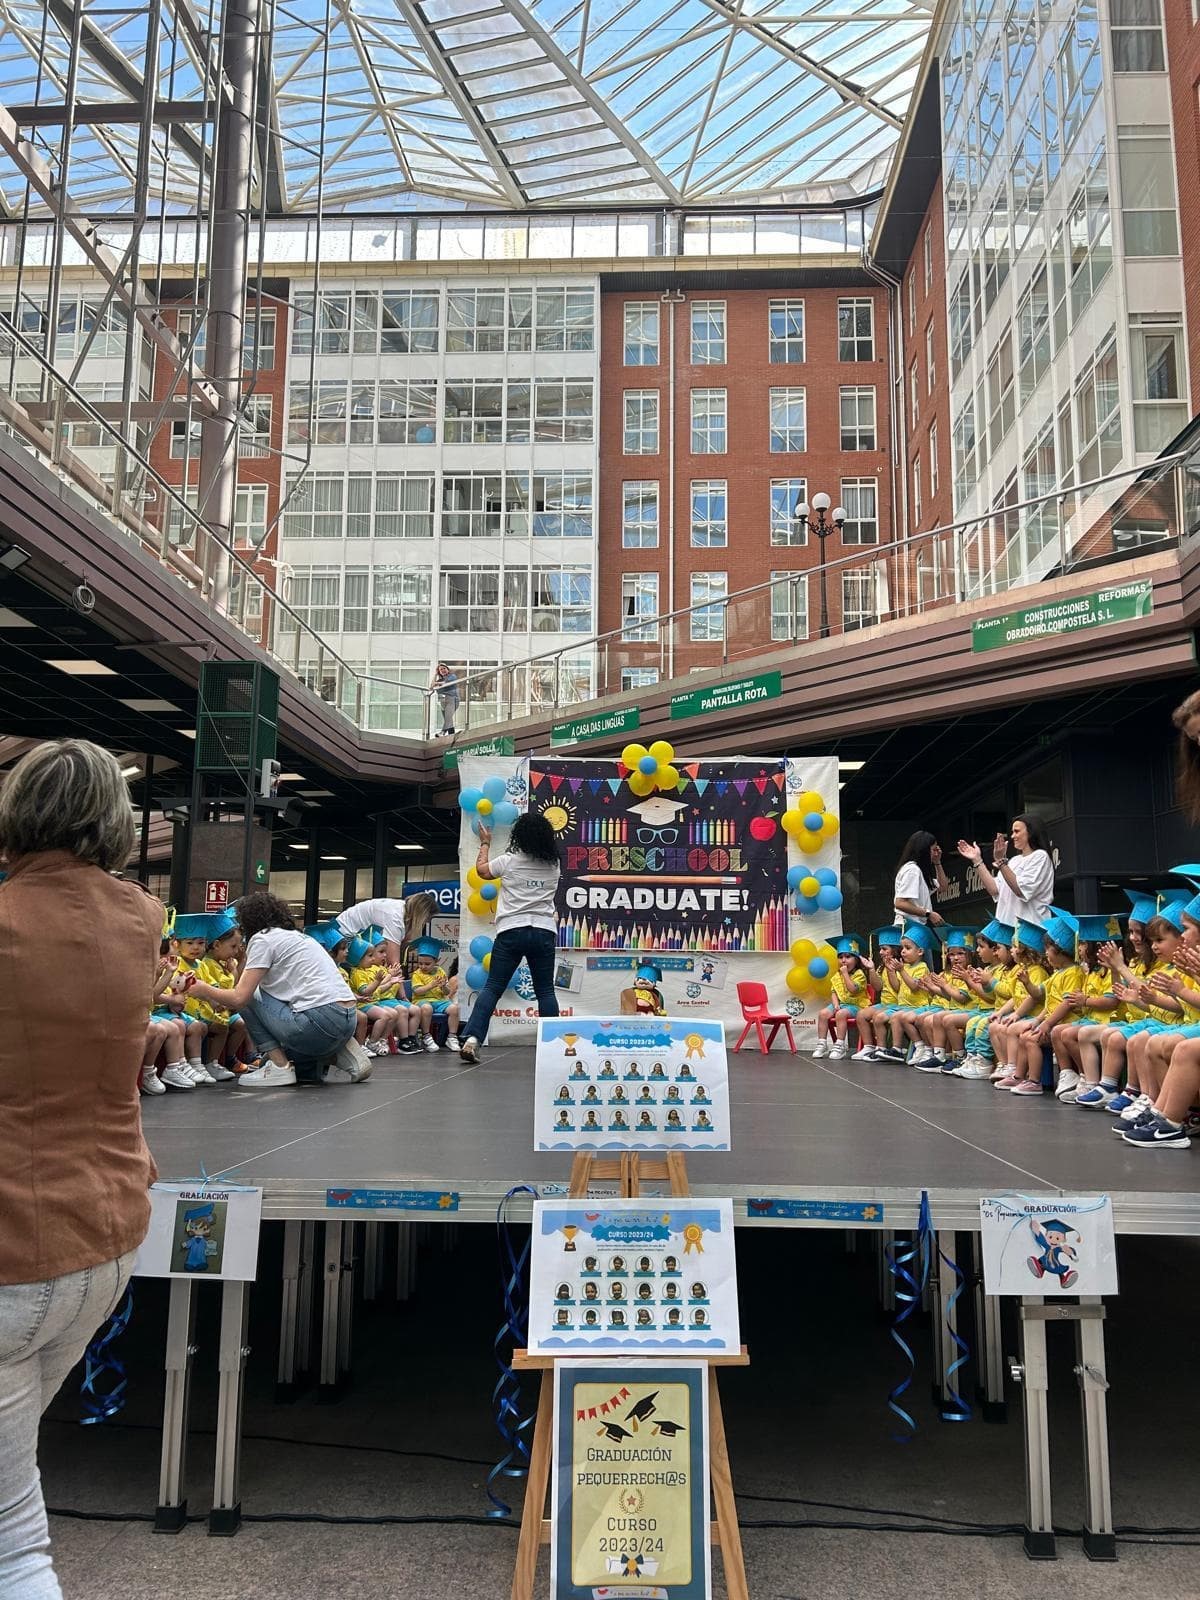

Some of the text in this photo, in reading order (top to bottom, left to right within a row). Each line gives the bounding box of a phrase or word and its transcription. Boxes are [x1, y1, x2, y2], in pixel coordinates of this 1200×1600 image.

[1098, 583, 1147, 603] REFORMAS
[1024, 600, 1090, 624] CONSTRUCCIONES
[1006, 622, 1047, 641] OBRADOIRO
[1047, 614, 1097, 632] COMPOSTELA
[701, 692, 743, 710] PANTALLA
[744, 686, 768, 700] ROTA
[571, 726, 576, 737] A
[576, 722, 590, 736] CASA
[590, 720, 601, 733] DAS
[566, 846, 749, 872] PRESCHOOL
[565, 887, 750, 912] GRADUATE!
[491, 1007, 521, 1017] Area
[180, 1191, 229, 1200] GRADUACIÓN
[1023, 1204, 1077, 1213] GRADUACIÓN
[587, 1446, 672, 1462] GRADUACIÓN
[577, 1471, 687, 1487] PEQUERRECH@S
[607, 1517, 657, 1531] CURSO
[599, 1537, 664, 1553] 2023/24
